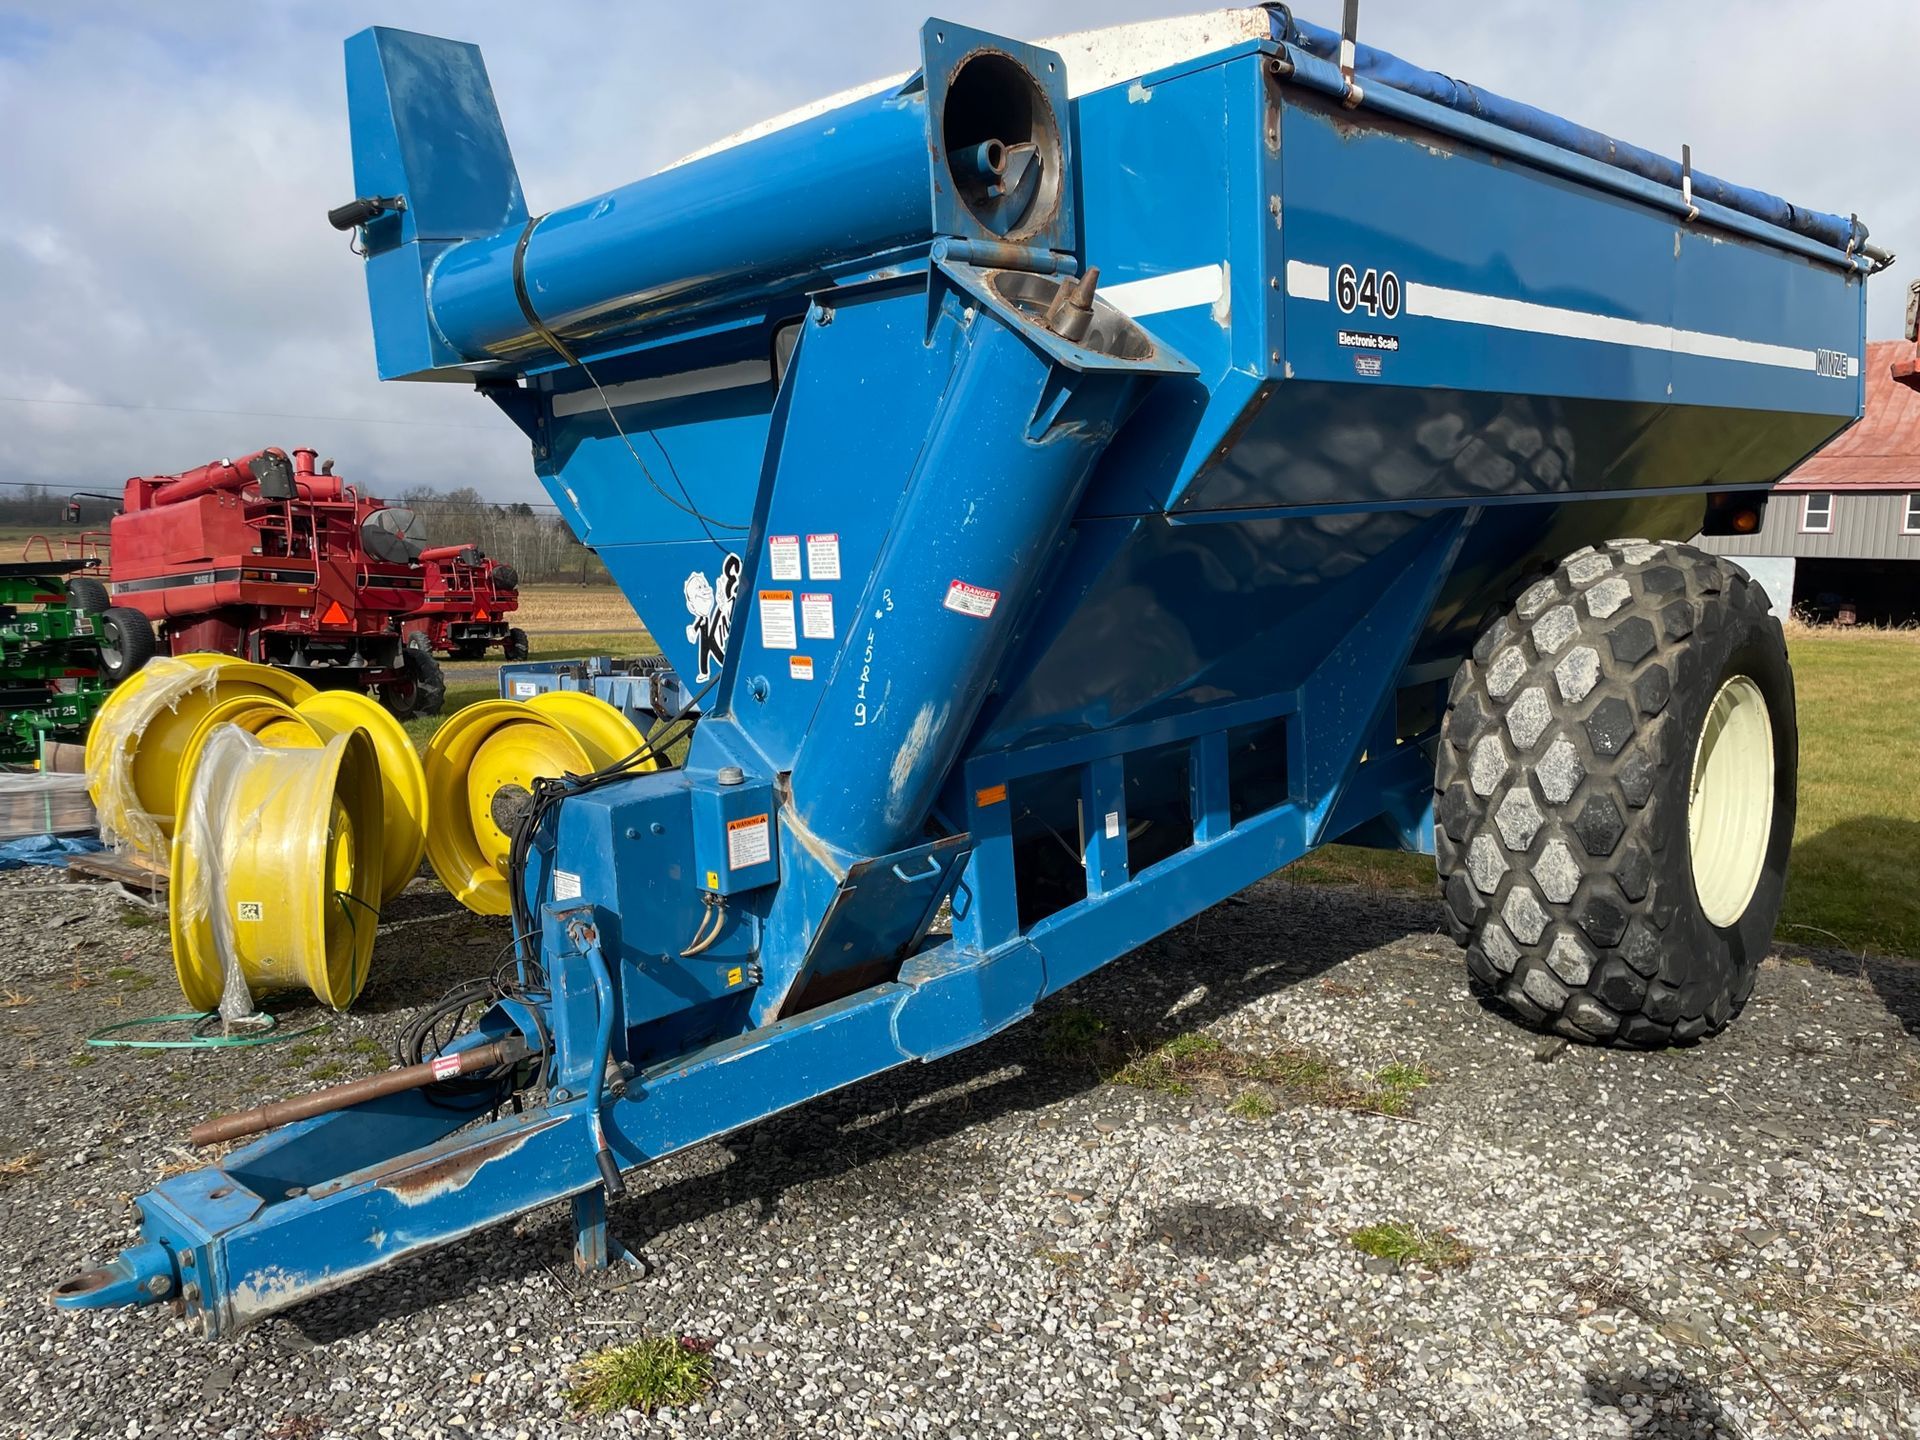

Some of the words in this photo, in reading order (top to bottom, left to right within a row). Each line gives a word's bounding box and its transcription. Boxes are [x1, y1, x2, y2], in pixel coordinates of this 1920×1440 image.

[1336, 264, 1400, 319] 640
[1339, 332, 1376, 347] Electronic
[1378, 336, 1398, 350] Scale
[1817, 348, 1847, 379] KINZE
[963, 585, 996, 599] DANGER
[24, 622, 39, 633] 25
[41, 708, 59, 718] HT
[62, 705, 77, 716] 25
[736, 817, 760, 829] WARNING
